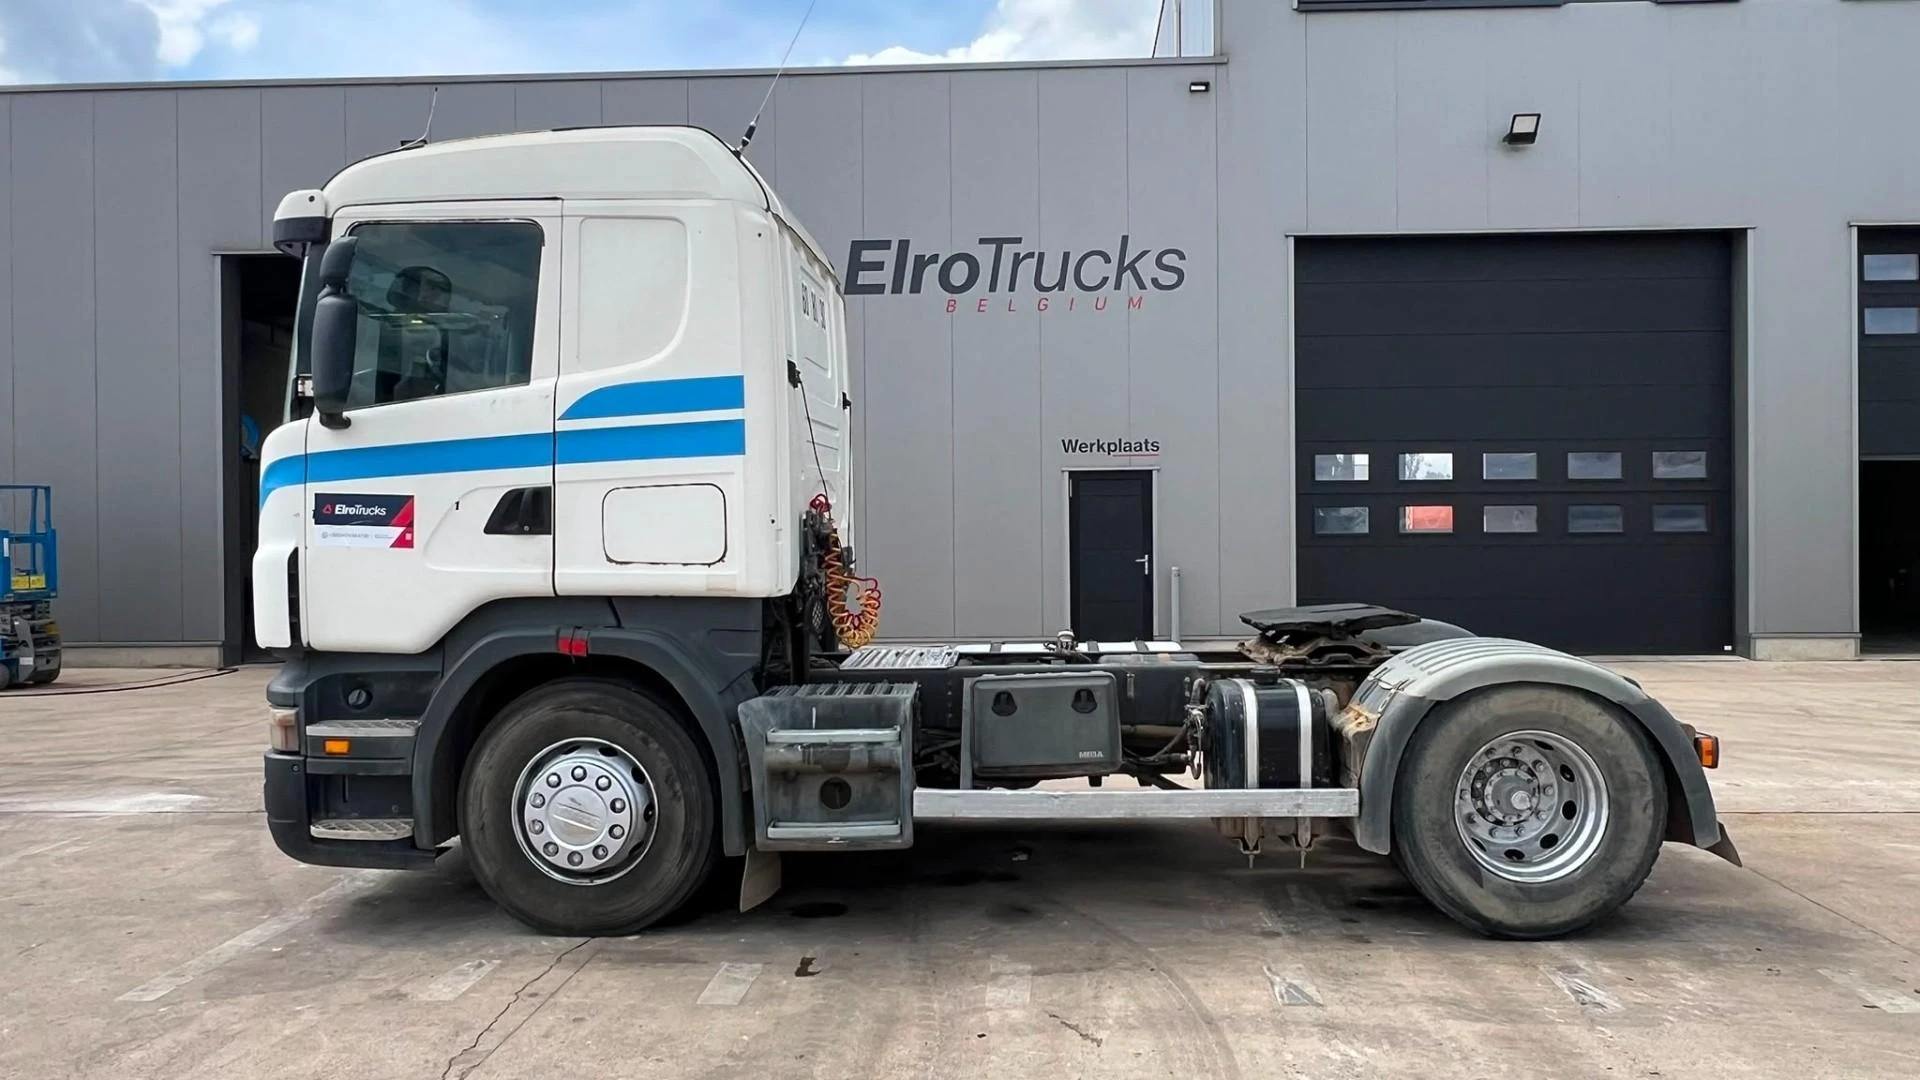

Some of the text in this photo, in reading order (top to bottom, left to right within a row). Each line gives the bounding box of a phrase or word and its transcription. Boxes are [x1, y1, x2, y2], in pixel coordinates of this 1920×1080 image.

[844, 235, 1187, 295] ElroTrucks
[946, 296, 1144, 313] BELGIUM
[1062, 438, 1160, 455] Werkplaats
[334, 504, 387, 516] ElroTrucks
